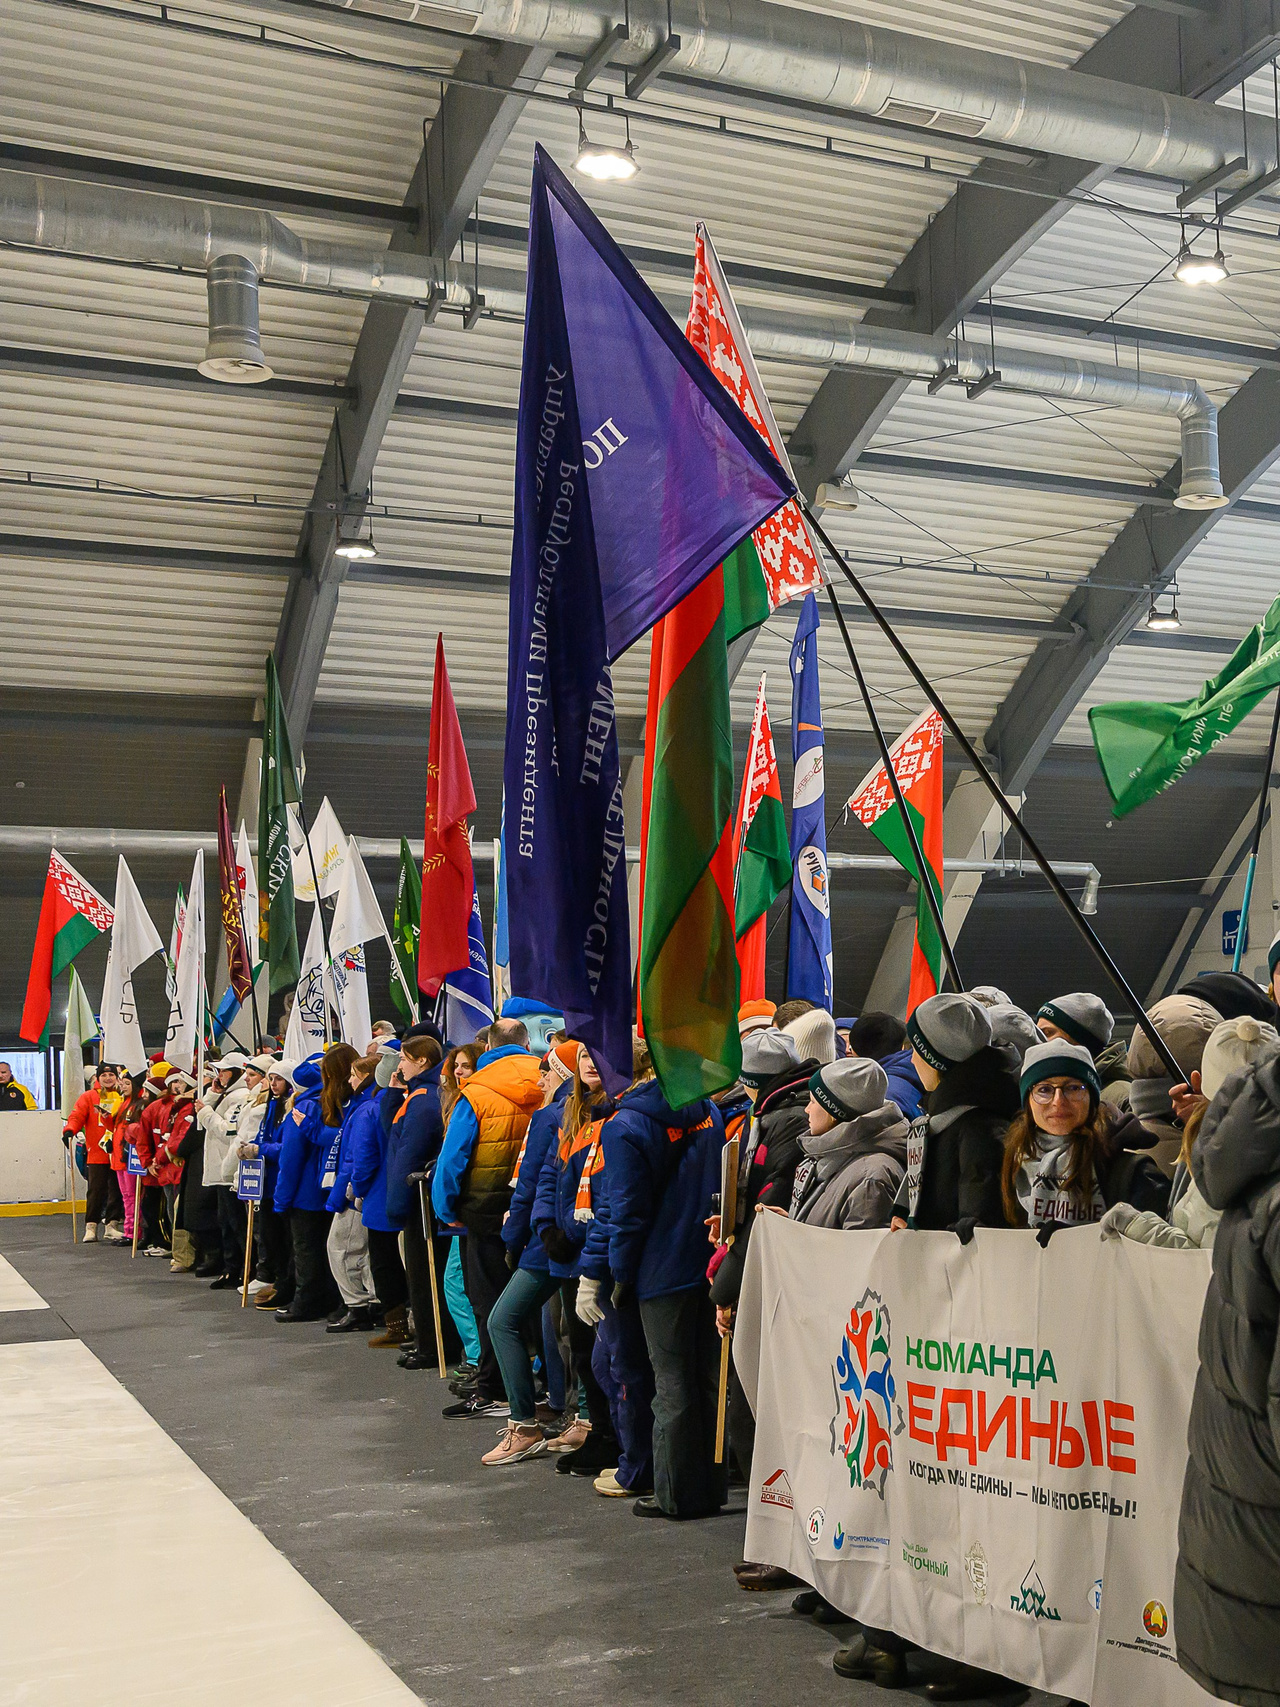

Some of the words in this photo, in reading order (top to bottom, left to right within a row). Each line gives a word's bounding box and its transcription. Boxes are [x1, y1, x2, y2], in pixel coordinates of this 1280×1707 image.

[550, 1057, 569, 1080] БЕЛАРУС
[912, 1033, 948, 1072] БЕЛАРУСЬ
[814, 1085, 848, 1120] БЕЛАРУСЬ
[1033, 1197, 1103, 1221] ЕДИНЫЕ
[906, 1335, 1058, 1390] КОМАНДА
[906, 1380, 1138, 1475] ЕДИНЫЕ
[761, 1492, 776, 1501] ДОМ
[908, 1459, 946, 1485] КОГДА
[947, 1468, 967, 1488] МЫ
[969, 1473, 1013, 1498] ЕДИНЫ
